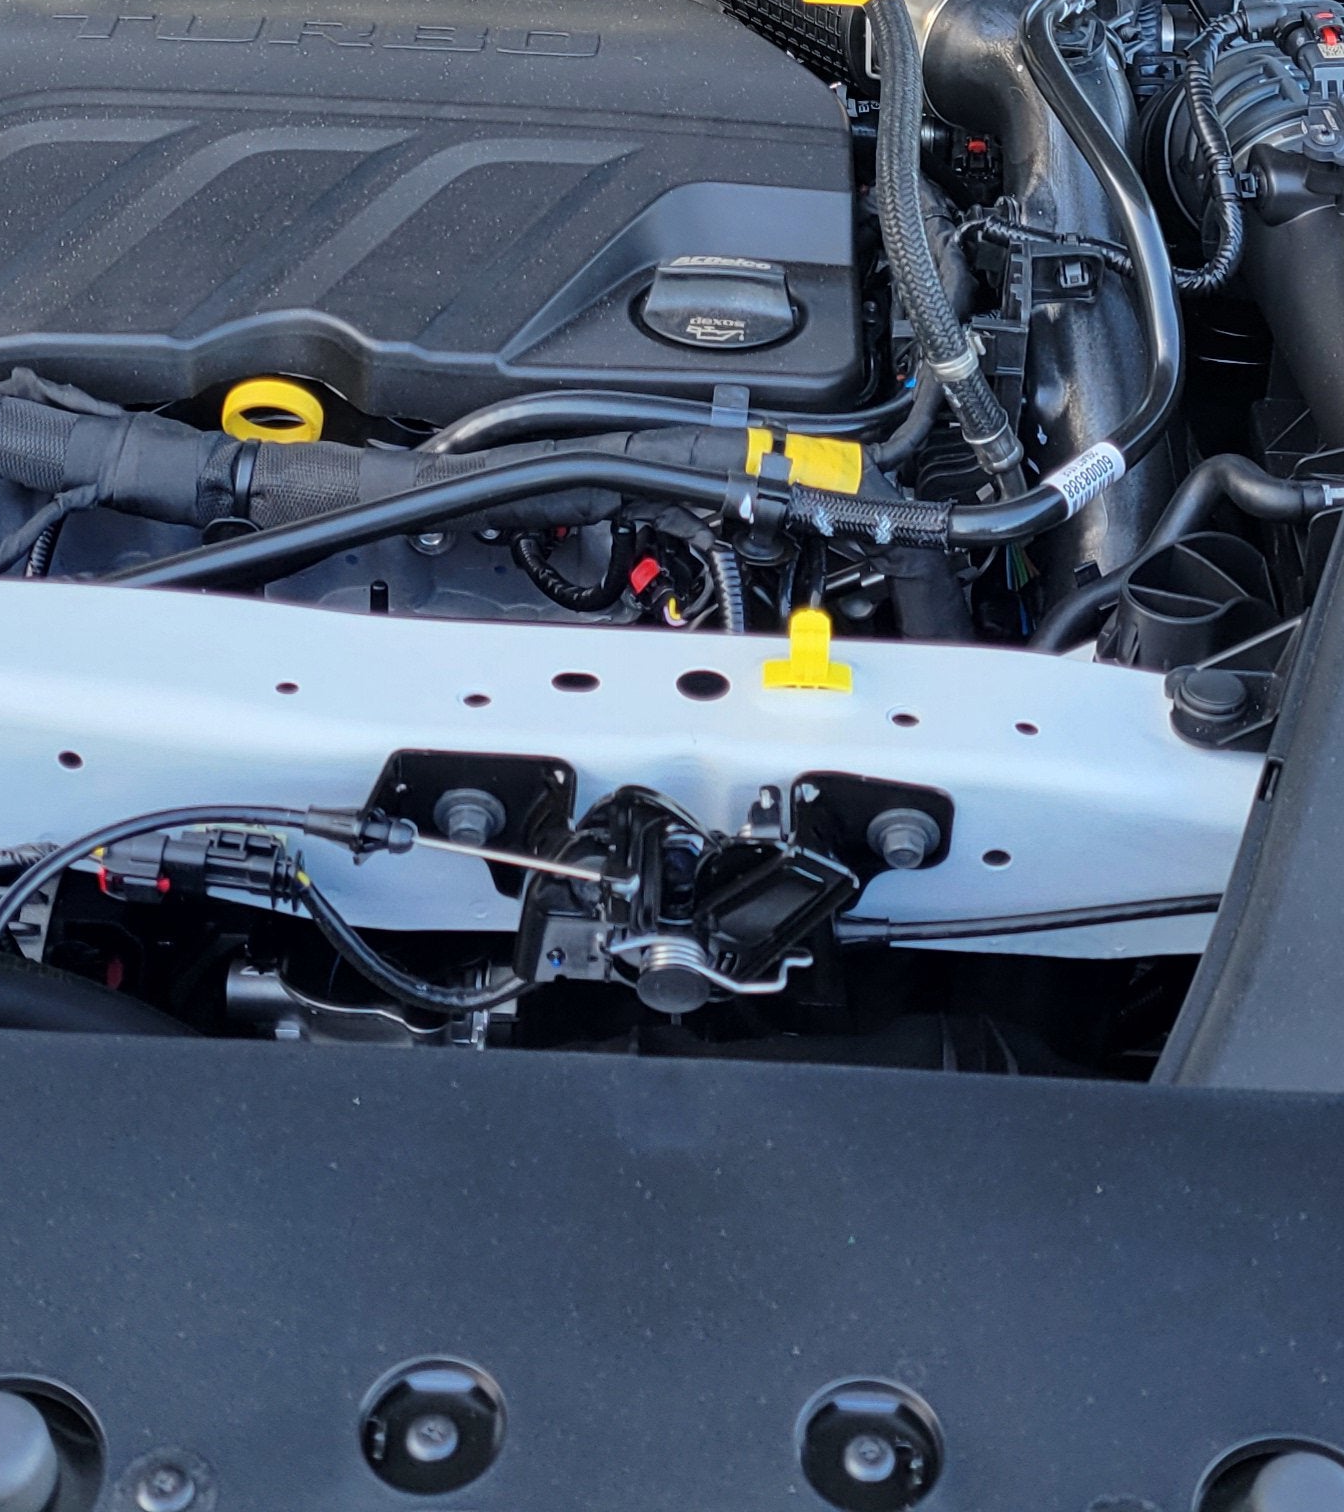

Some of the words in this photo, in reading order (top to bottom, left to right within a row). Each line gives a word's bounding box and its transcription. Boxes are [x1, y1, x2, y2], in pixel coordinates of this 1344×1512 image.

[51, 14, 601, 58] TURBO
[670, 255, 772, 270] ACDelco
[689, 316, 746, 329] dexos
[1063, 454, 1114, 500] 60008388
